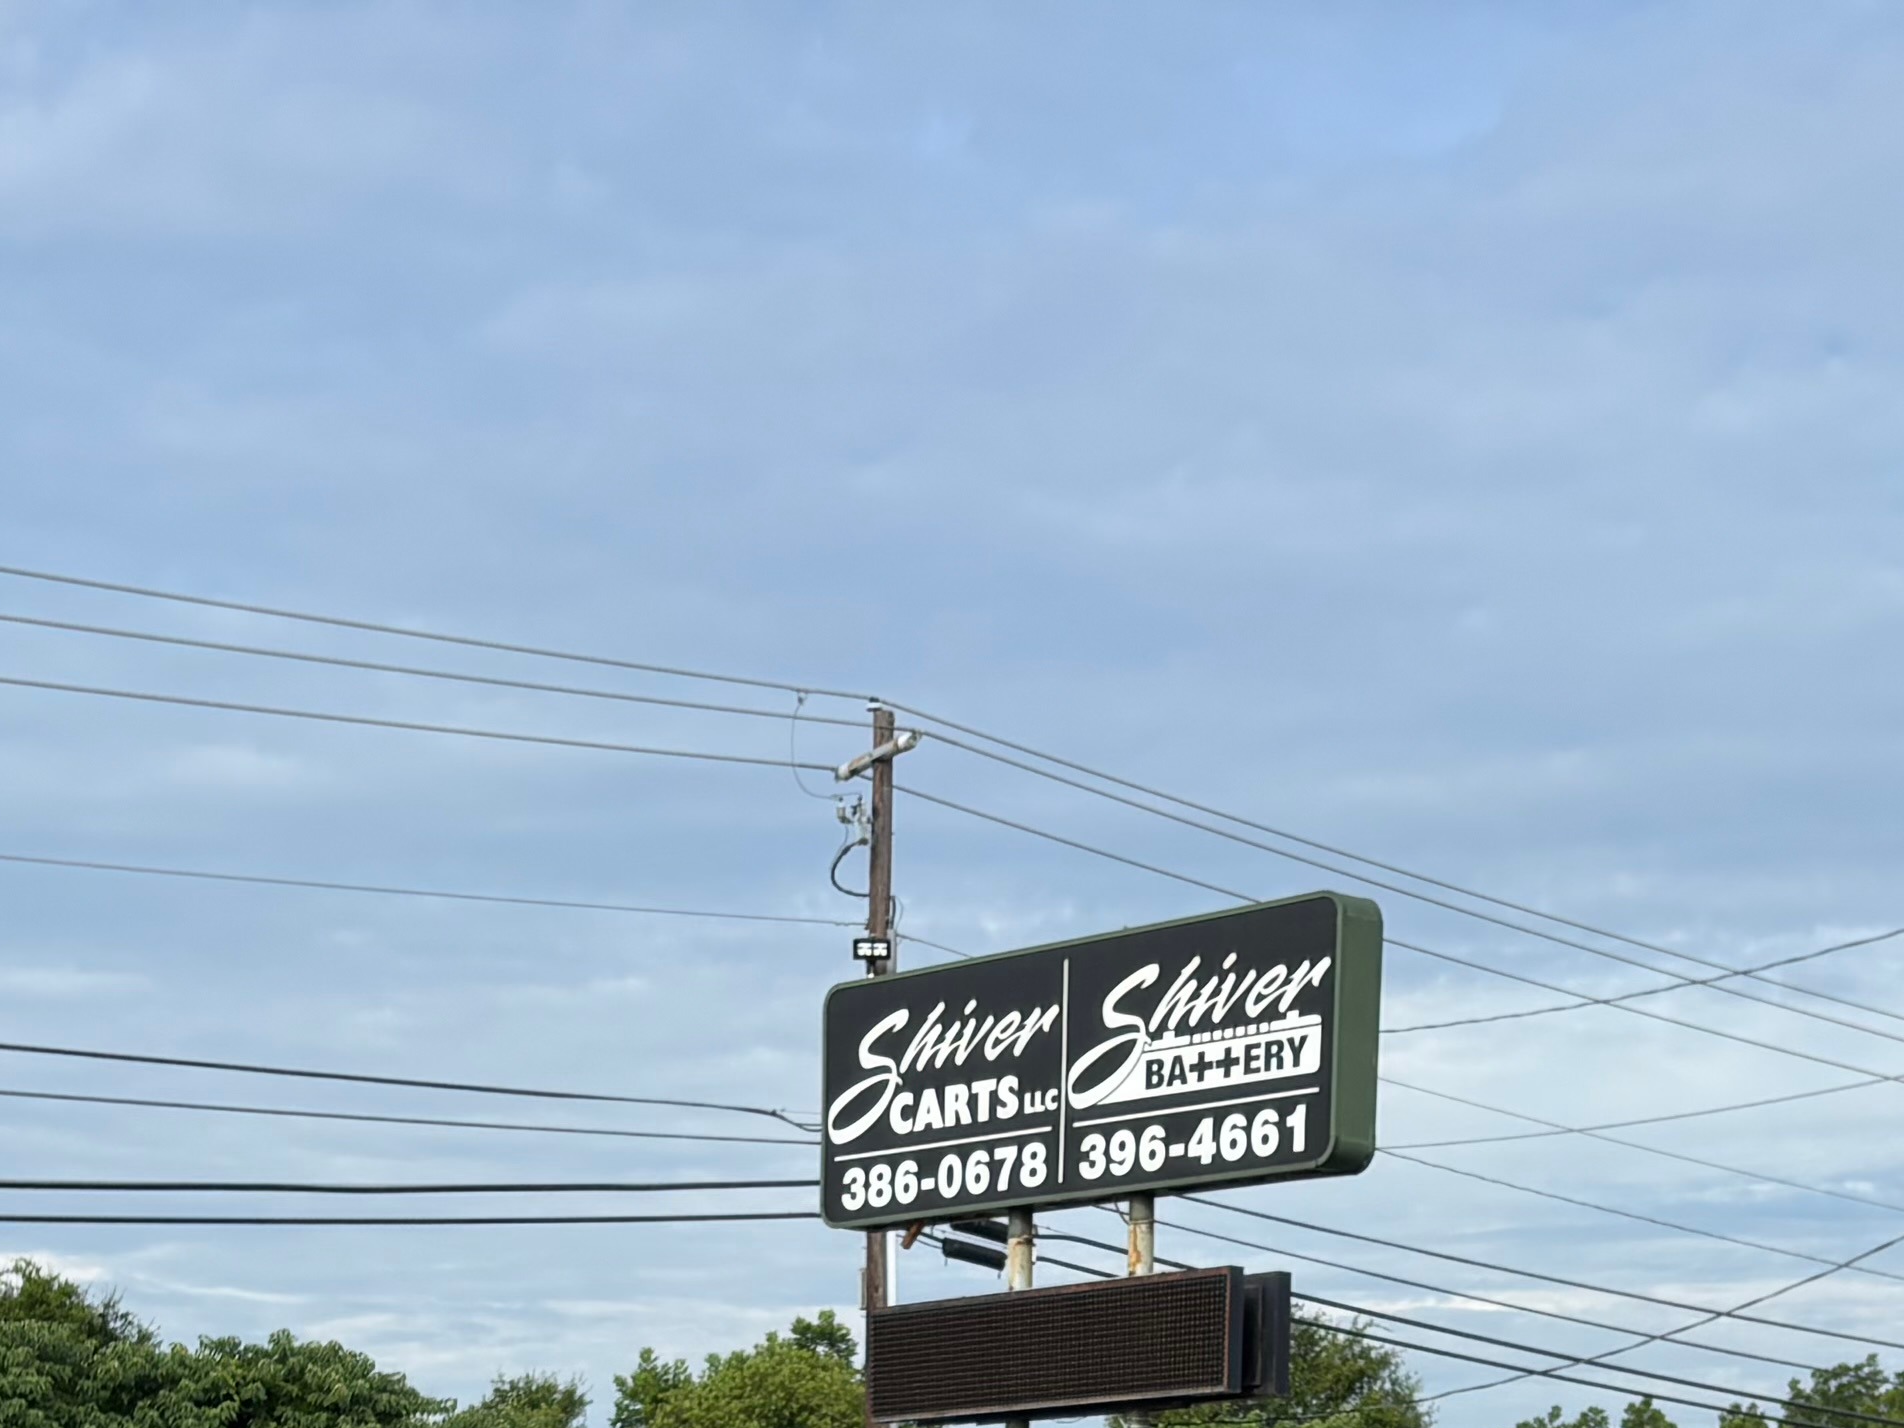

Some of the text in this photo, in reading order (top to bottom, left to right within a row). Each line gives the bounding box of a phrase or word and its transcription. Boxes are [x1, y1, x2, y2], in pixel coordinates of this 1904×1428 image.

[1069, 951, 1332, 1110] Shiver
[828, 999, 1060, 1146] Shiver
[889, 1075, 1059, 1135] CARTS LLC
[841, 1141, 1049, 1212] 386-0678
[1078, 1103, 1308, 1181] 396-4661
